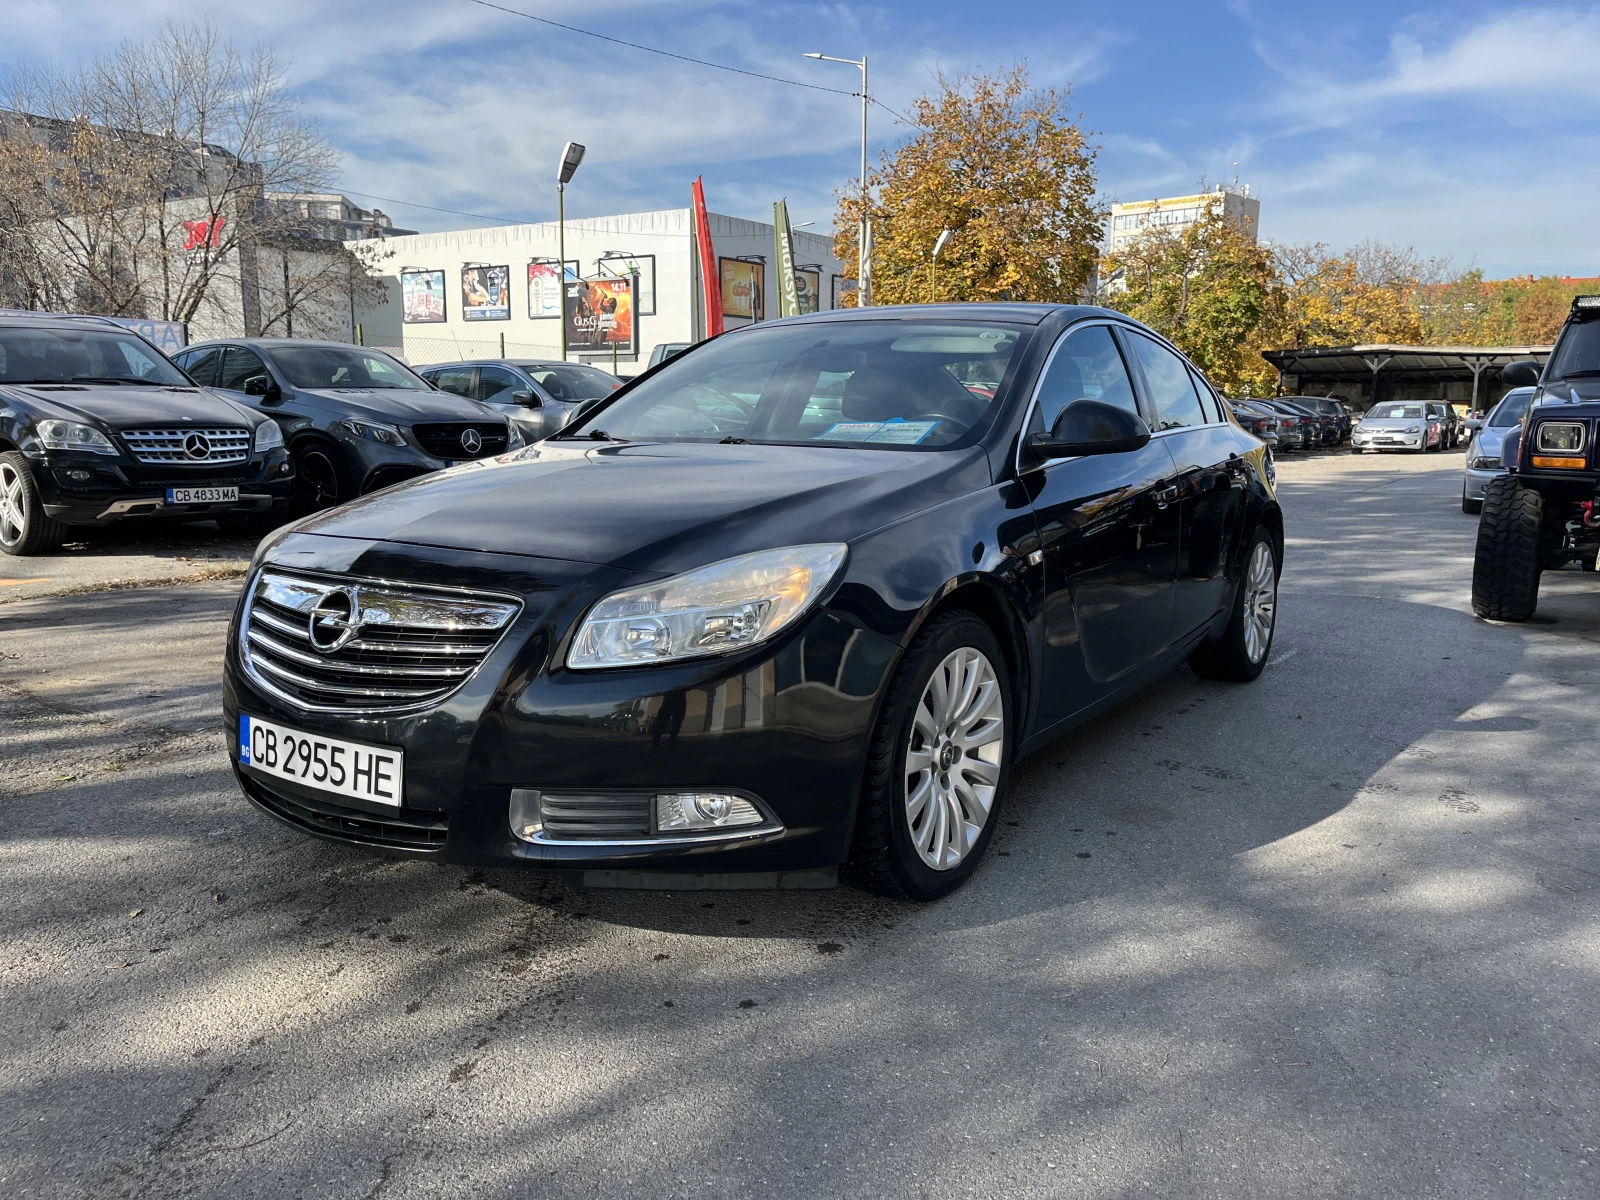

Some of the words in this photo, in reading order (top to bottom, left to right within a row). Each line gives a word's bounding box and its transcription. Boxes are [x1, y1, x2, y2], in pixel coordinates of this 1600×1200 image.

[611, 282, 626, 292] 14.11
[175, 490, 191, 502] CB
[194, 489, 221, 501] 4833
[222, 489, 237, 500] MA
[241, 743, 250, 757] BG
[252, 725, 278, 768] CB
[283, 736, 346, 787] 2955
[353, 751, 393, 799] HE
